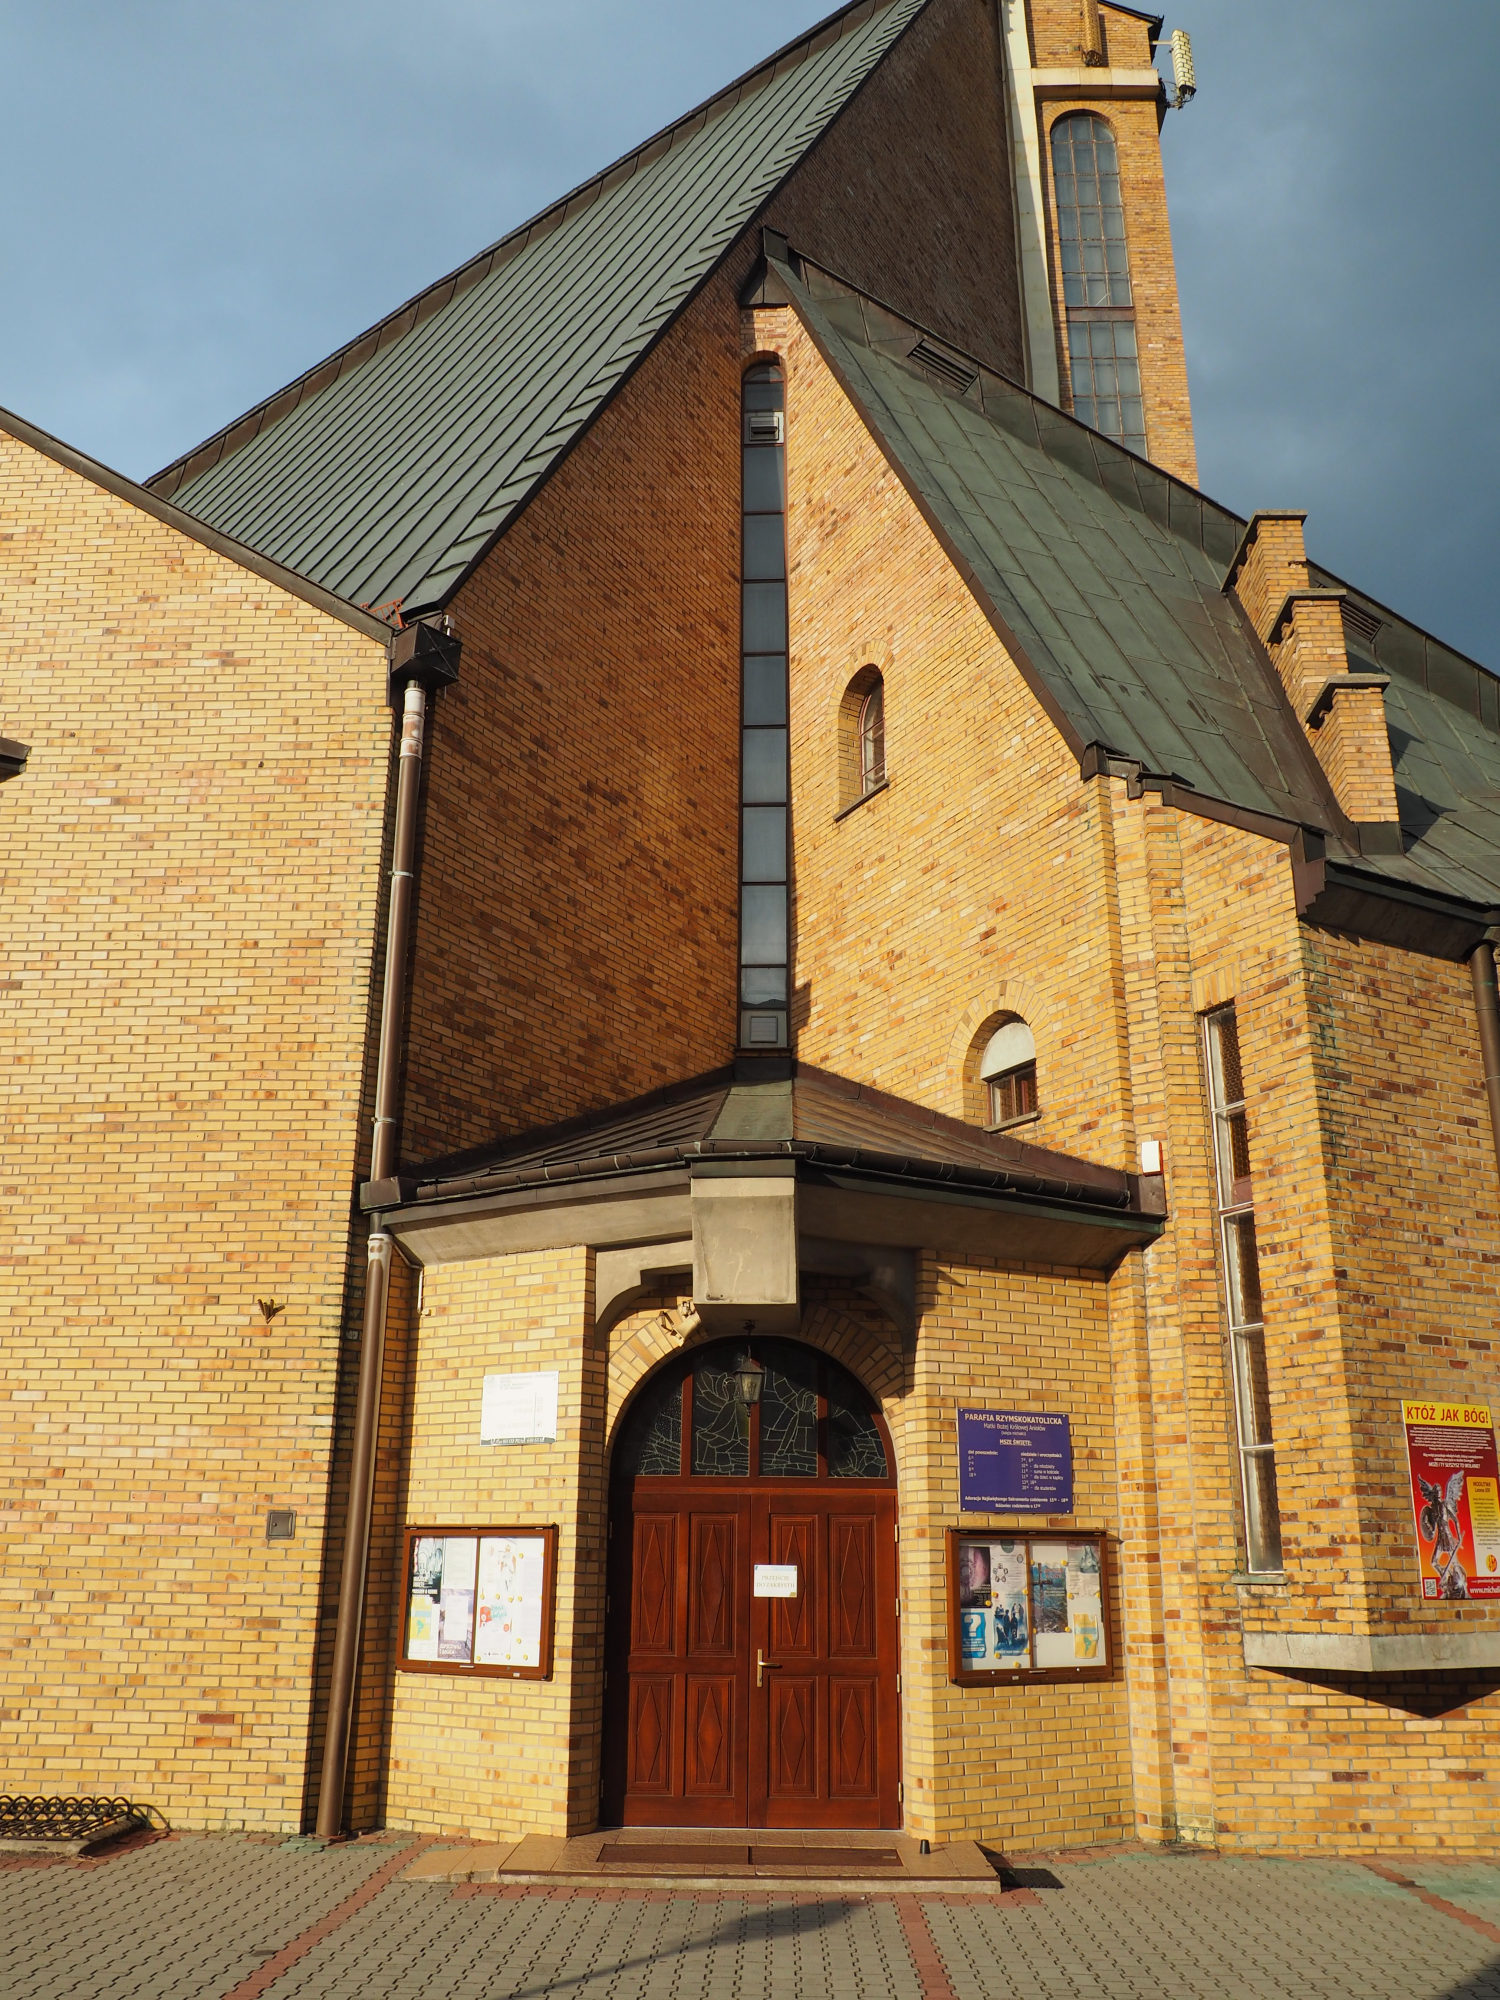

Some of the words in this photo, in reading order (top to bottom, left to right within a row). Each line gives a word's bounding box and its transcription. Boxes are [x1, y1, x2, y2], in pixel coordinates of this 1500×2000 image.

[964, 1413, 995, 1421] PARAFIA
[995, 1414, 1063, 1425] RZYMSKOKATOLICKA
[1406, 1404, 1436, 1421] KTÓŻ
[1440, 1408, 1460, 1422] JAK
[1464, 1408, 1489, 1424] BÓG!
